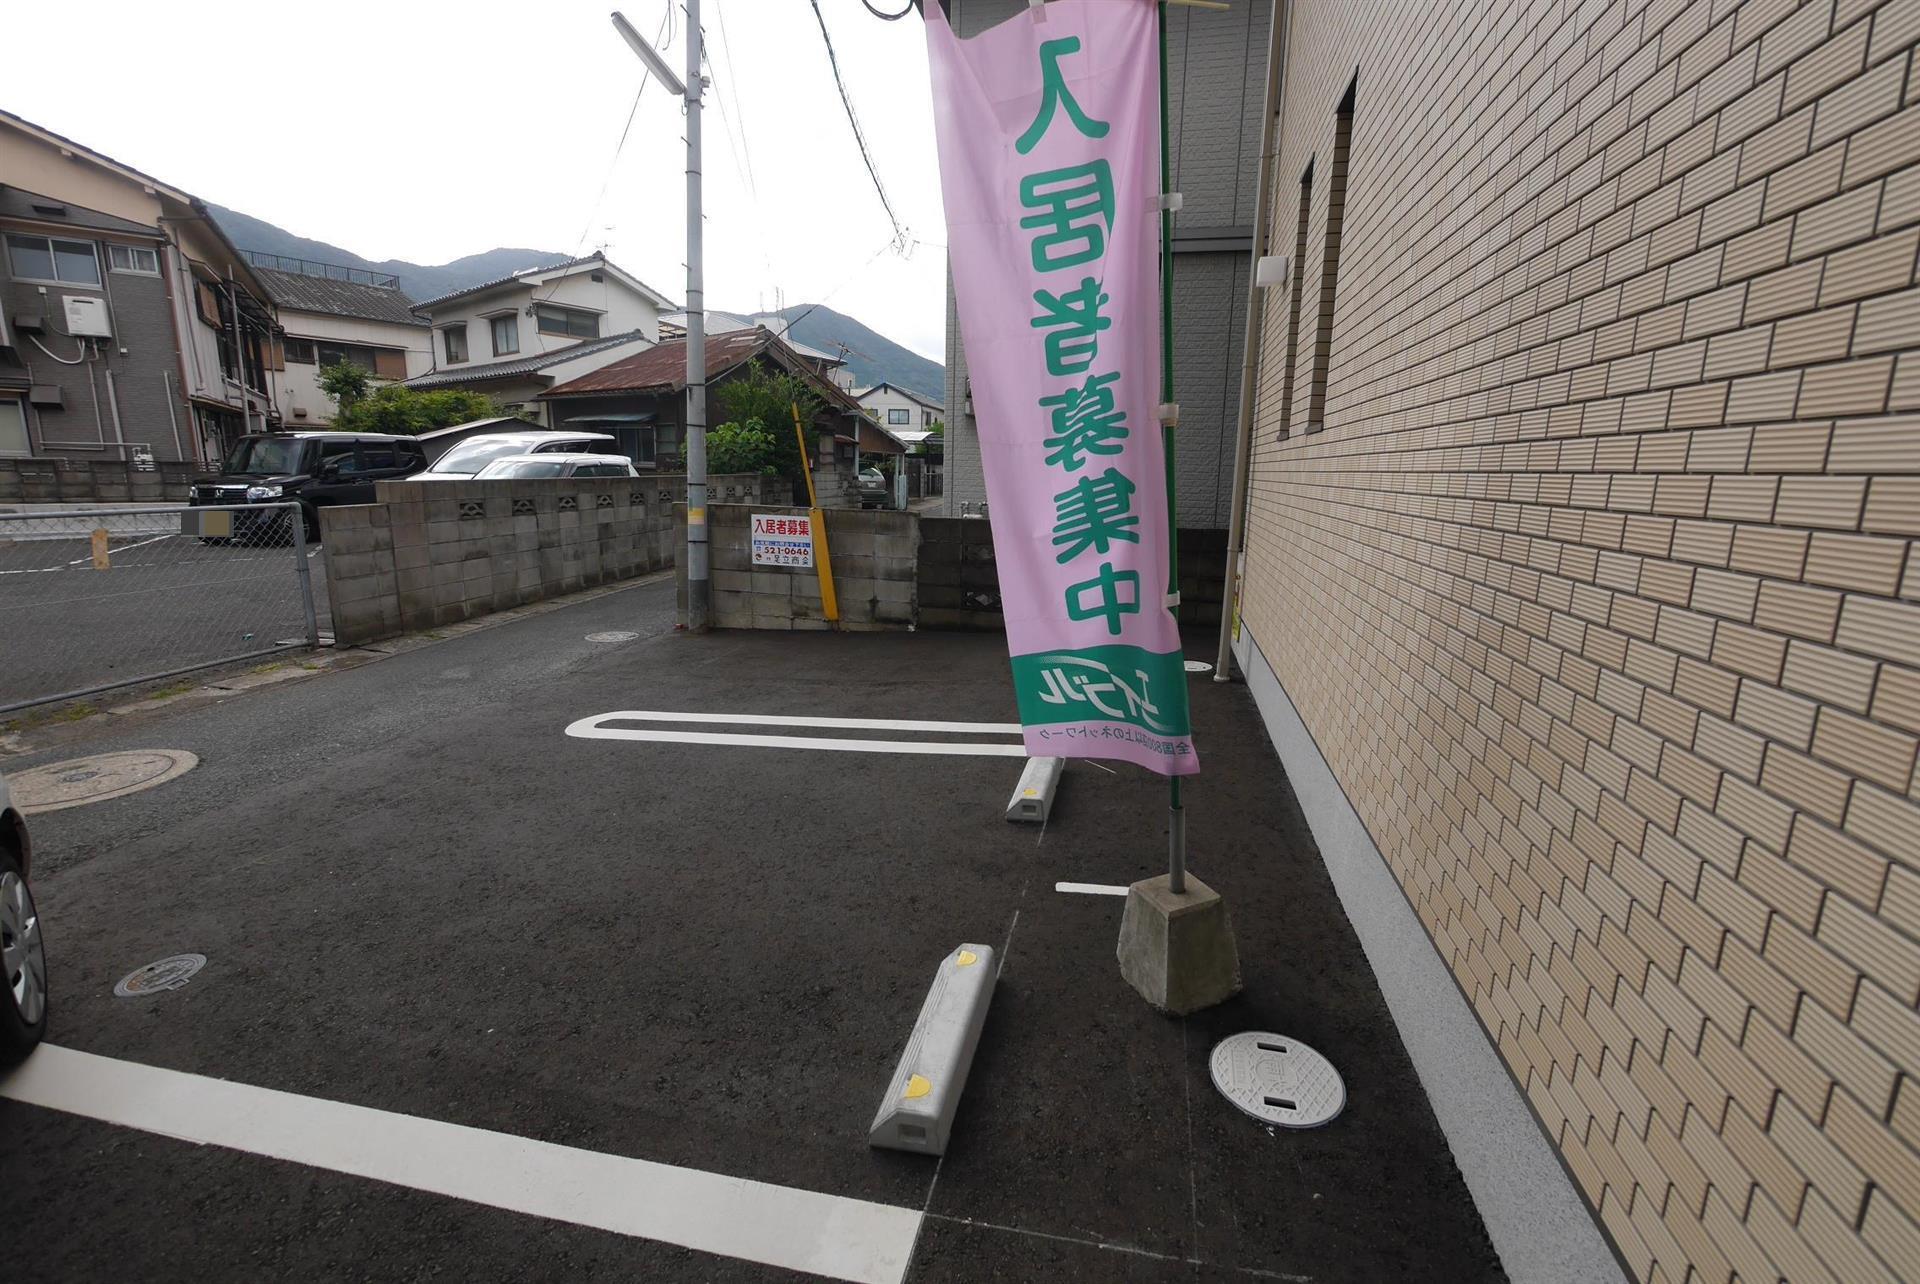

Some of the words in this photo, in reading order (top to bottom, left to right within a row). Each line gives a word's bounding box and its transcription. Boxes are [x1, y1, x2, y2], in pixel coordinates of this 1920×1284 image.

[754, 519, 809, 536] 入居者募集
[764, 546, 809, 556] 521-0646
